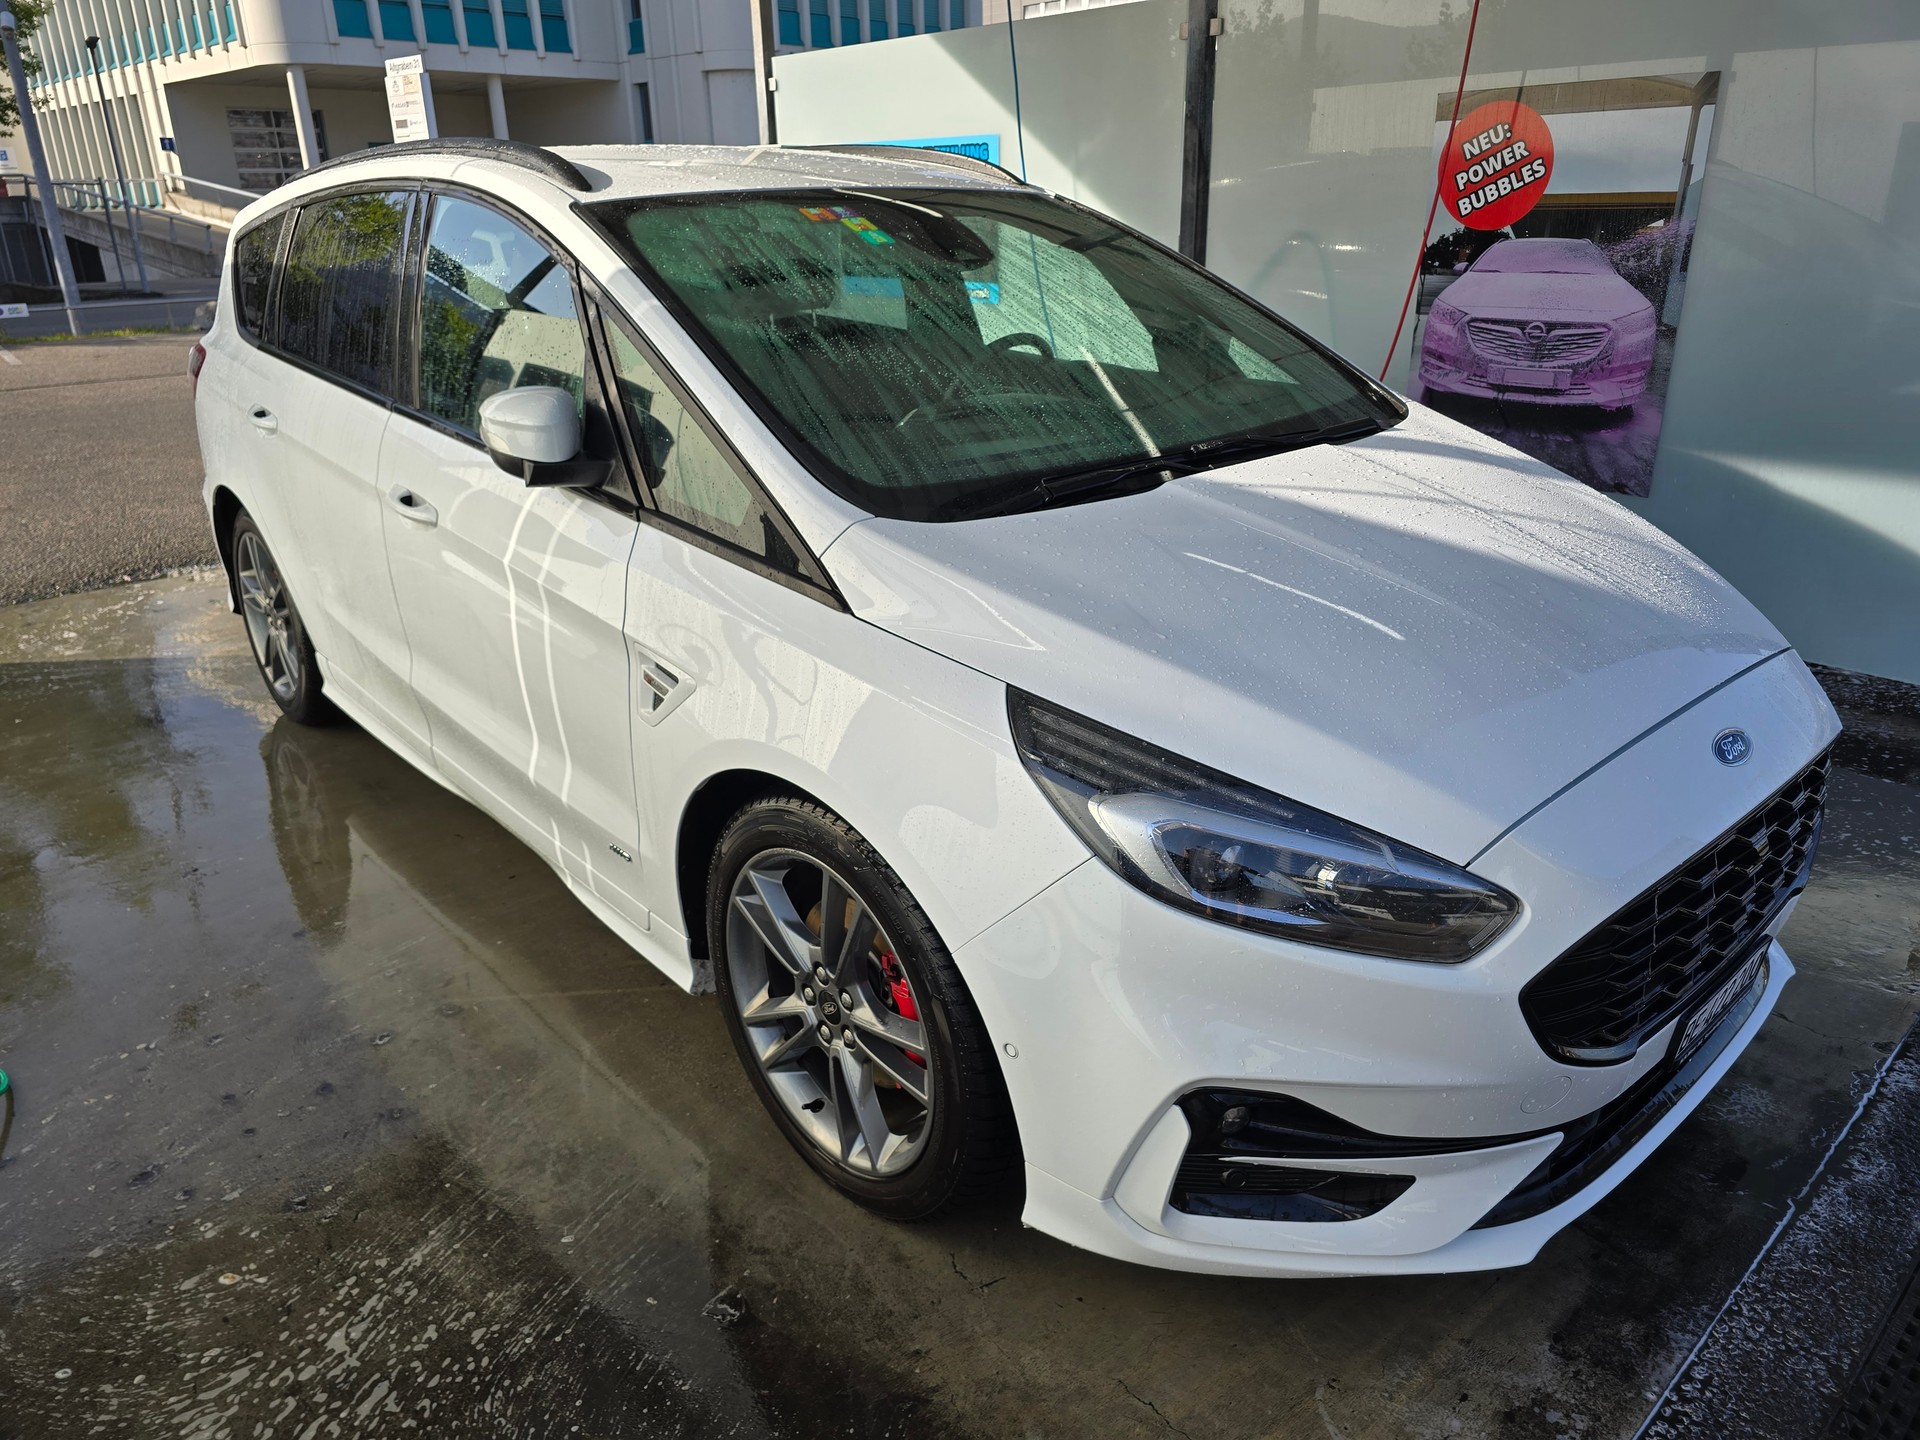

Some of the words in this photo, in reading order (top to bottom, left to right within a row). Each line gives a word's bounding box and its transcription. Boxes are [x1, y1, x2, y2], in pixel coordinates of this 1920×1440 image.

[1462, 123, 1512, 160] NEU:
[1455, 141, 1530, 191] POWER
[1457, 157, 1547, 217] BUBBLES
[1720, 736, 1746, 760] Ford
